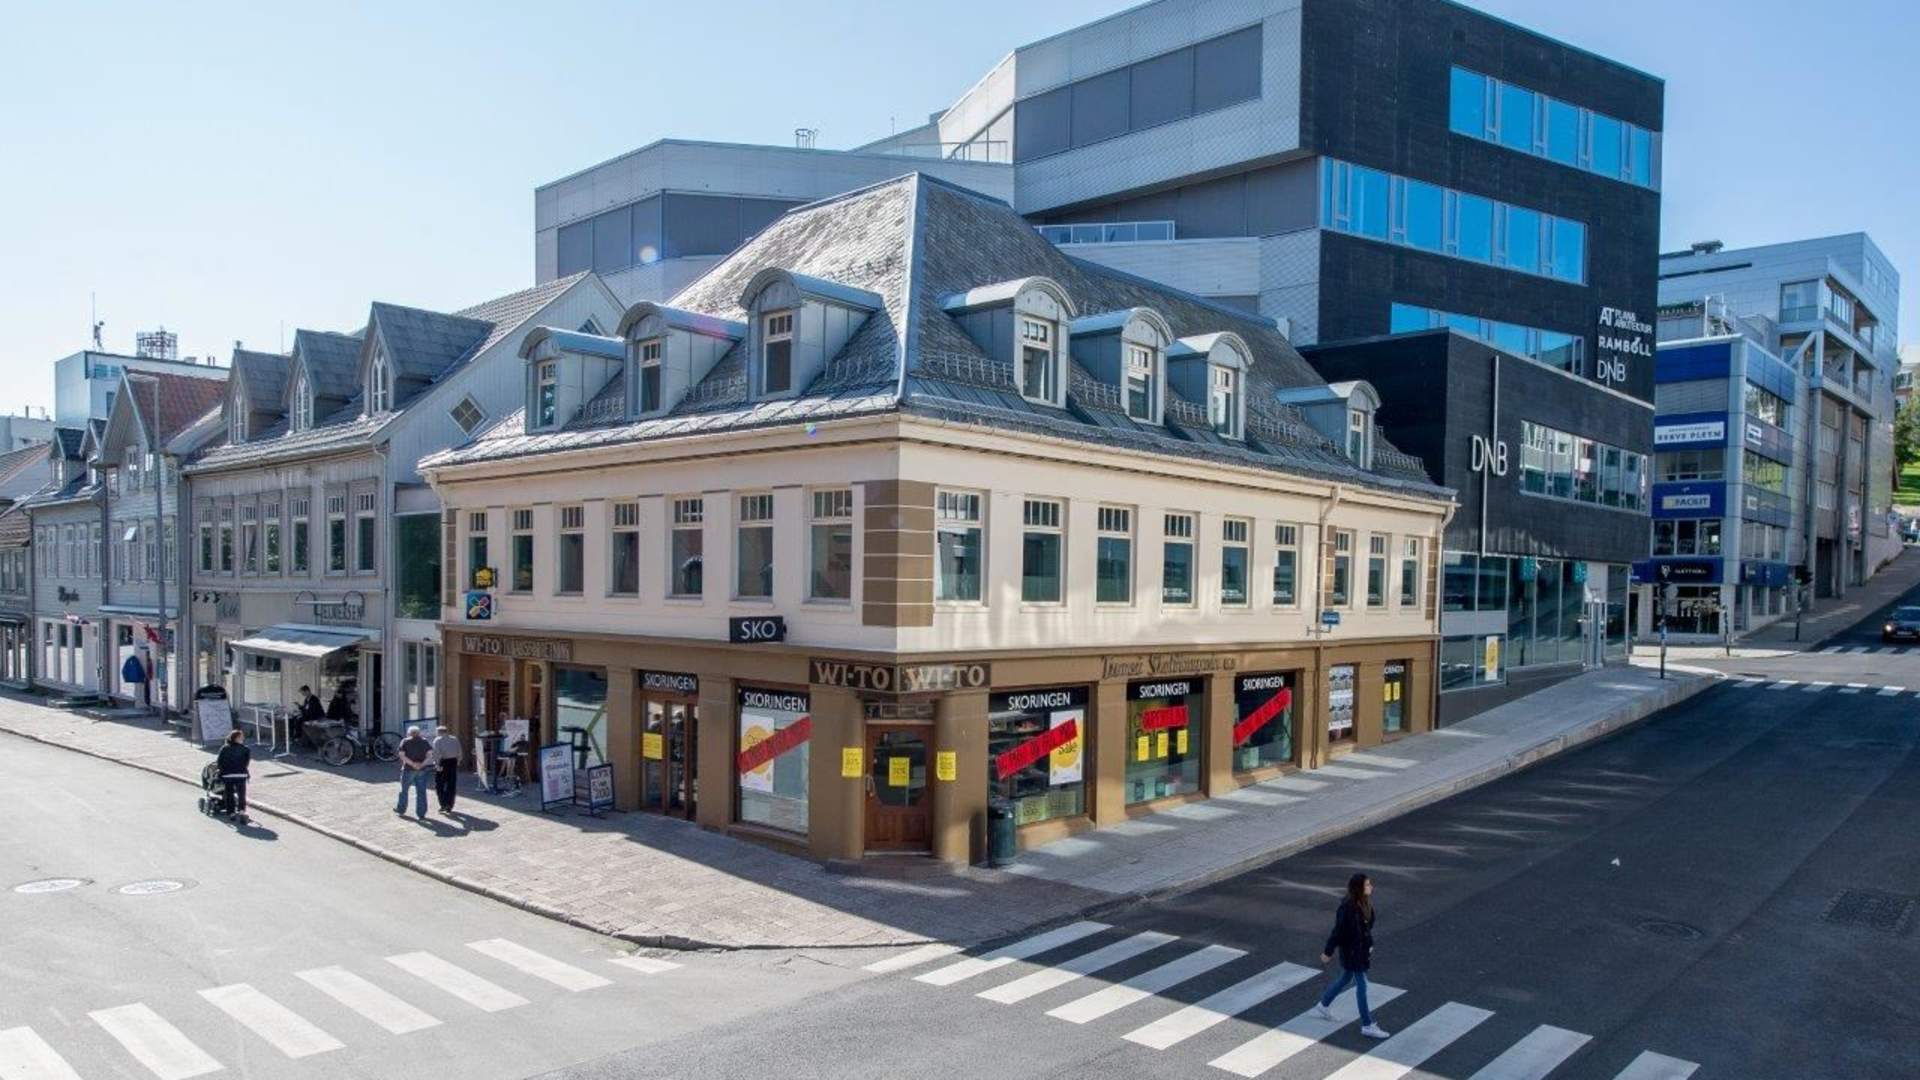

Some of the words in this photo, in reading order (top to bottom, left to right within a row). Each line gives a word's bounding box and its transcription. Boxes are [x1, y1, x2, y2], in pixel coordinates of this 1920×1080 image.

[1600, 307, 1614, 326] AT
[1597, 356, 1626, 387] DNB
[1472, 434, 1508, 476] DNB
[741, 620, 776, 639] SKO
[644, 672, 696, 689] SKORINGEN
[1139, 682, 1190, 698] SKORINGEN
[1242, 676, 1284, 691] SKORINGEN
[744, 692, 806, 711] SKORINGEN
[1008, 692, 1071, 711] SKORINGEN
